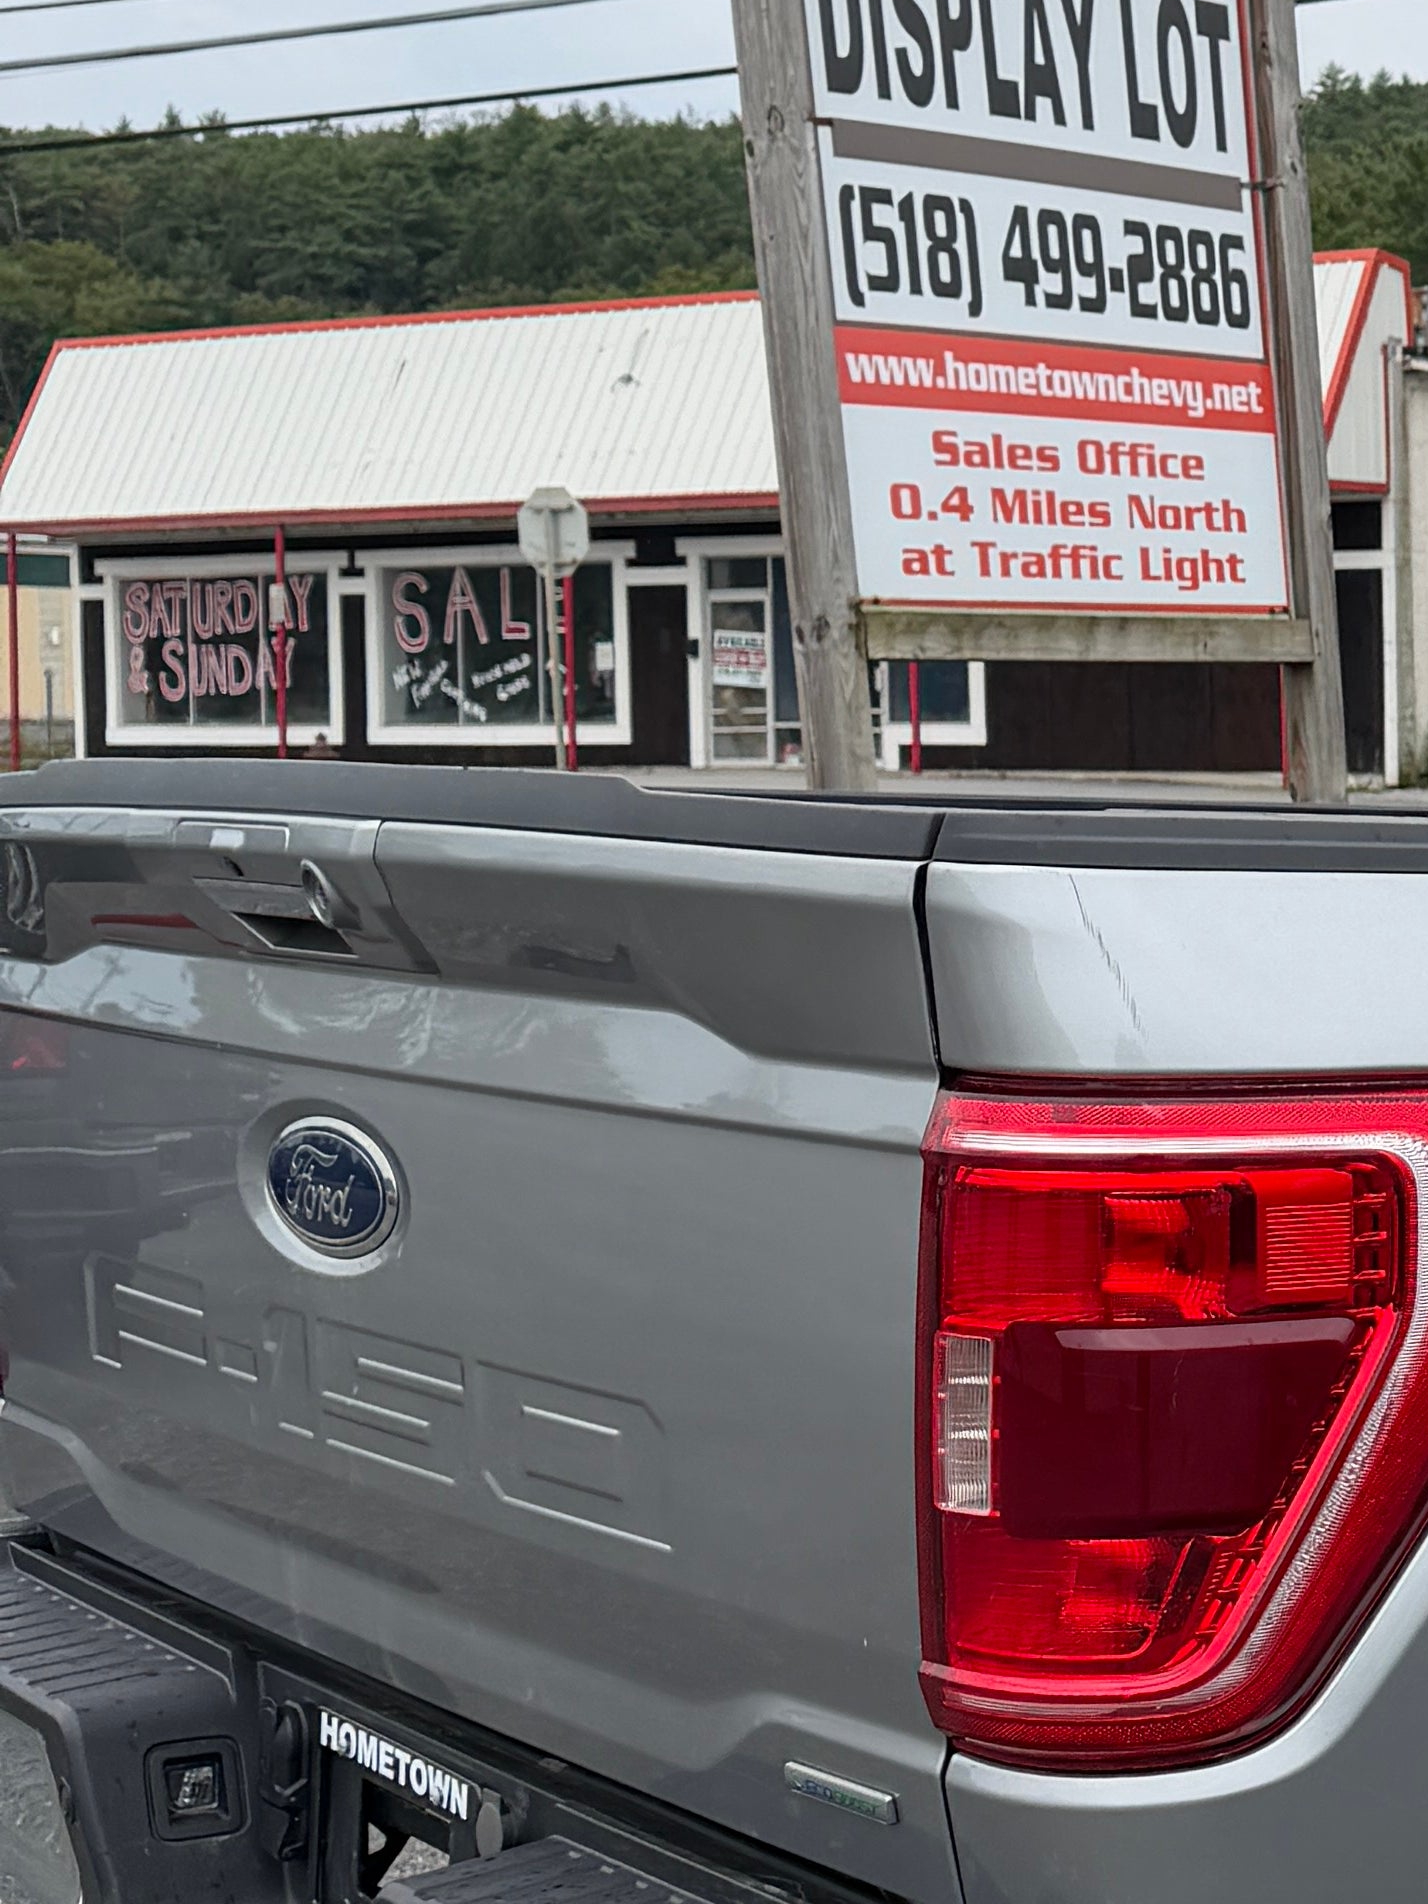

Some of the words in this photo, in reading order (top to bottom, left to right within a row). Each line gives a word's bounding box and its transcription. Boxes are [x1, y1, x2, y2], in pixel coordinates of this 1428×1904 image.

[838, 182, 982, 319] (518)
[1002, 204, 1252, 330] 499-2886
[845, 350, 1264, 419] www.hometownchevy.net
[932, 430, 1060, 474] Sales
[1077, 439, 1205, 481] Office
[889, 484, 974, 524] 0.4
[991, 487, 1112, 529] Miles
[1128, 494, 1249, 534] North
[901, 544, 955, 578] at
[971, 541, 1123, 582] Traffic
[1138, 546, 1247, 591] Light
[127, 645, 149, 694] &
[158, 637, 297, 703] SUNDAY
[285, 1143, 356, 1228] Ford
[84, 1252, 675, 1552] F-150
[320, 1711, 470, 1821] HOMETOWN
